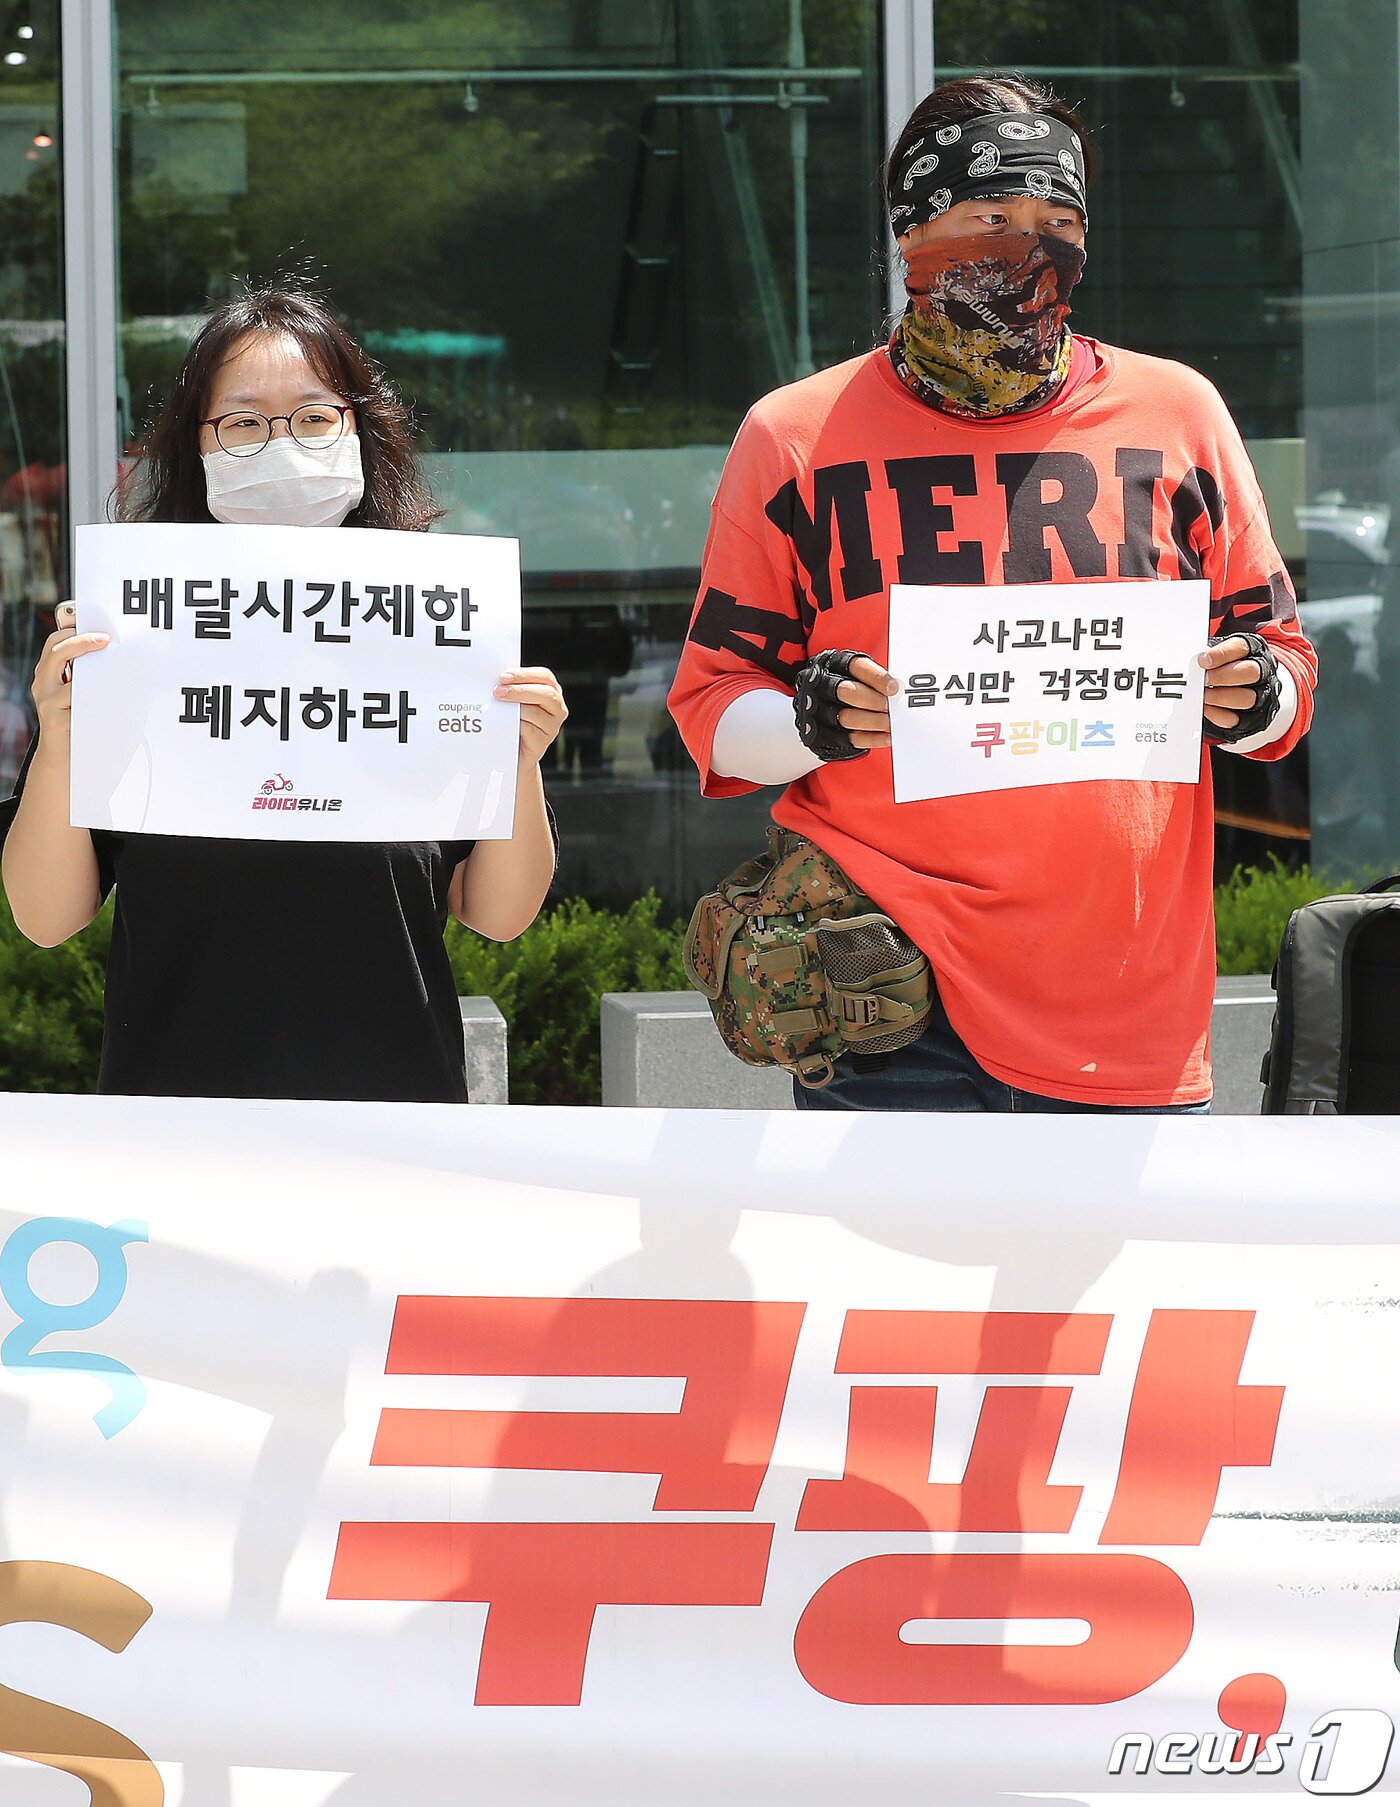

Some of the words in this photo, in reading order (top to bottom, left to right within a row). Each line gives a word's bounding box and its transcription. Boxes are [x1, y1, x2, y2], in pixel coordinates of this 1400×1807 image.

[122, 577, 479, 648] 배달시간제한
[972, 616, 1124, 654] 사고나면
[904, 670, 1016, 708] 음식만
[1039, 666, 1188, 702] 걱정하는
[179, 685, 417, 744] 폐지하라
[438, 702, 483, 714] coupang
[438, 715, 483, 733] eats
[970, 718, 1116, 759] 쿠팡이츠
[1135, 731, 1168, 743] eats
[252, 797, 343, 812] 라이더유니온
